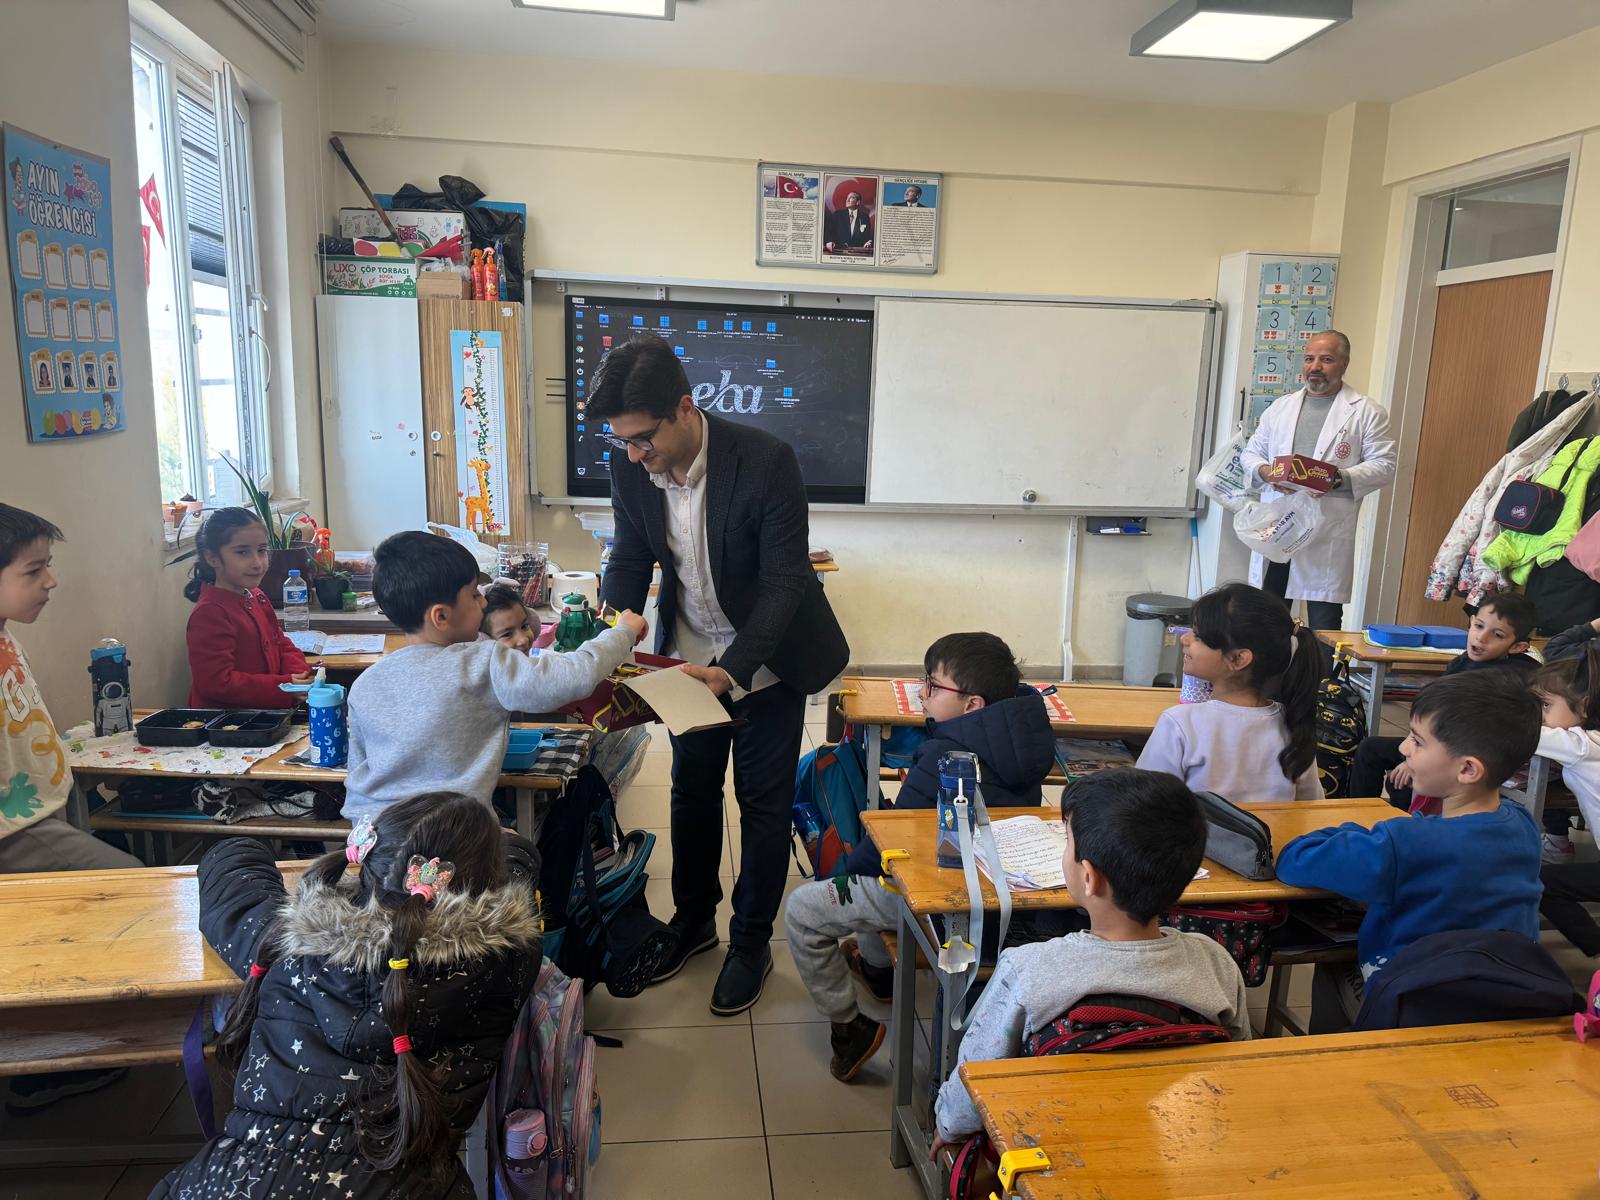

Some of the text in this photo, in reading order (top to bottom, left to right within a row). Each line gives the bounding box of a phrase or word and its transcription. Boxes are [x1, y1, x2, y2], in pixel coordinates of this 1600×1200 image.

[28, 160, 60, 198] AYIN
[29, 193, 97, 238] ÖĞRENCİSİ
[333, 263, 357, 273] LIXO
[360, 265, 376, 274] ÇÖP
[1277, 266, 1281, 282] 1
[1312, 267, 1322, 283] 2
[1269, 310, 1280, 329] 3
[1304, 311, 1317, 330] 4
[1266, 356, 1278, 373] 5
[691, 369, 764, 414] eba
